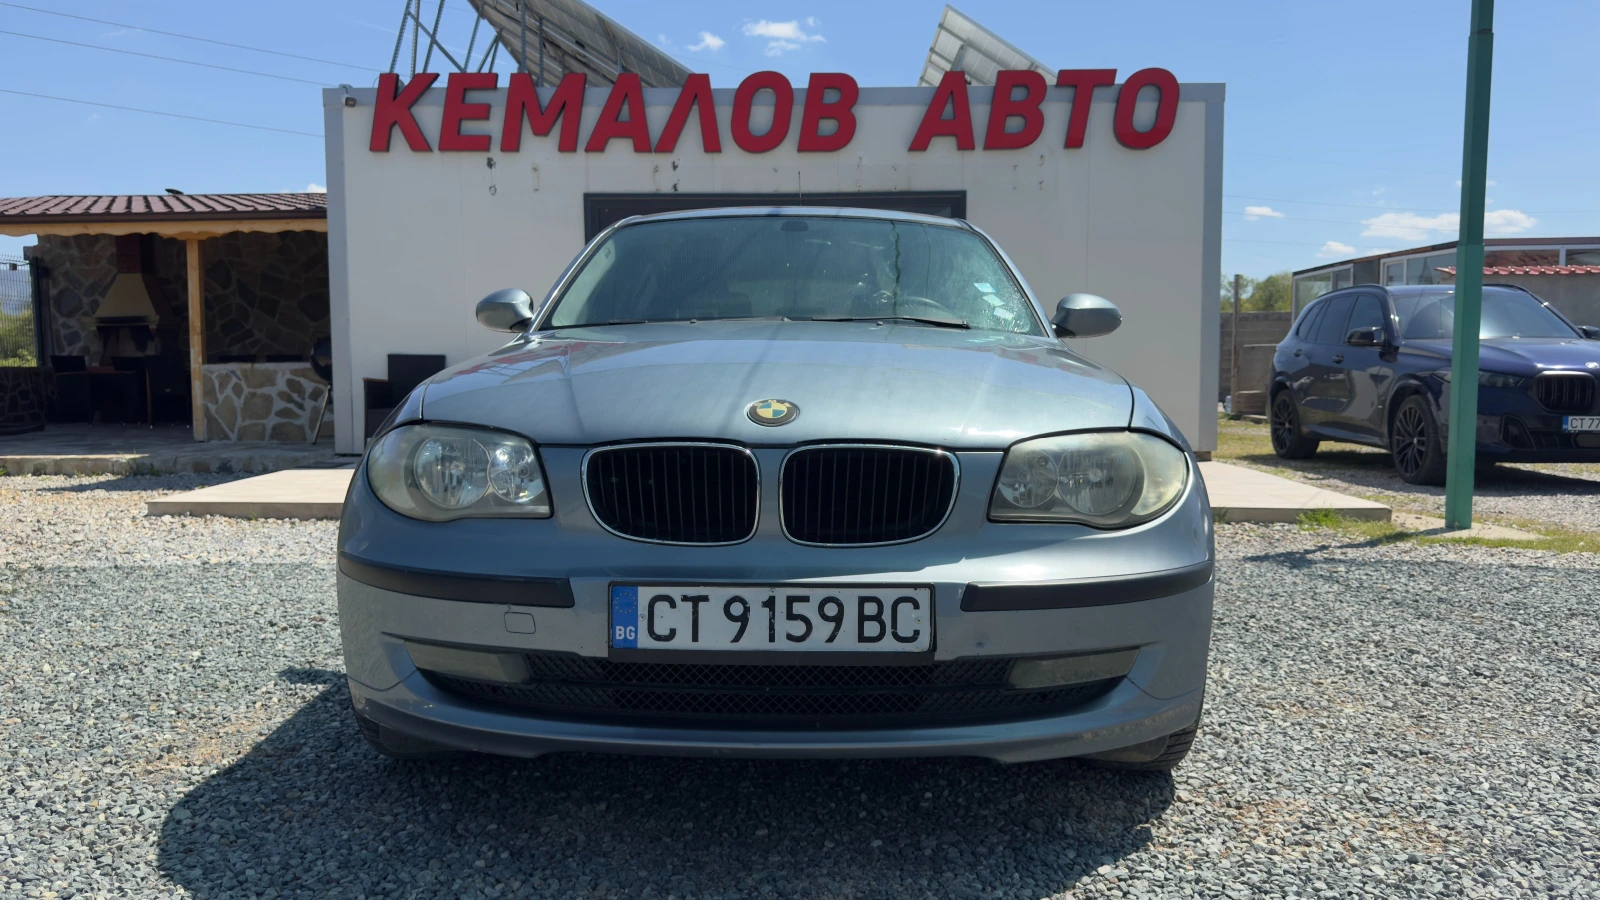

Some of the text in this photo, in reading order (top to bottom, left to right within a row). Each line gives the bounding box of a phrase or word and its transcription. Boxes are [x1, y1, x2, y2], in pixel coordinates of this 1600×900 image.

[369, 67, 1180, 153] КЕМАЛОВ АВТО
[1570, 417, 1586, 429] CT
[615, 625, 636, 641] BG
[647, 594, 921, 645] CT 9159 BC
